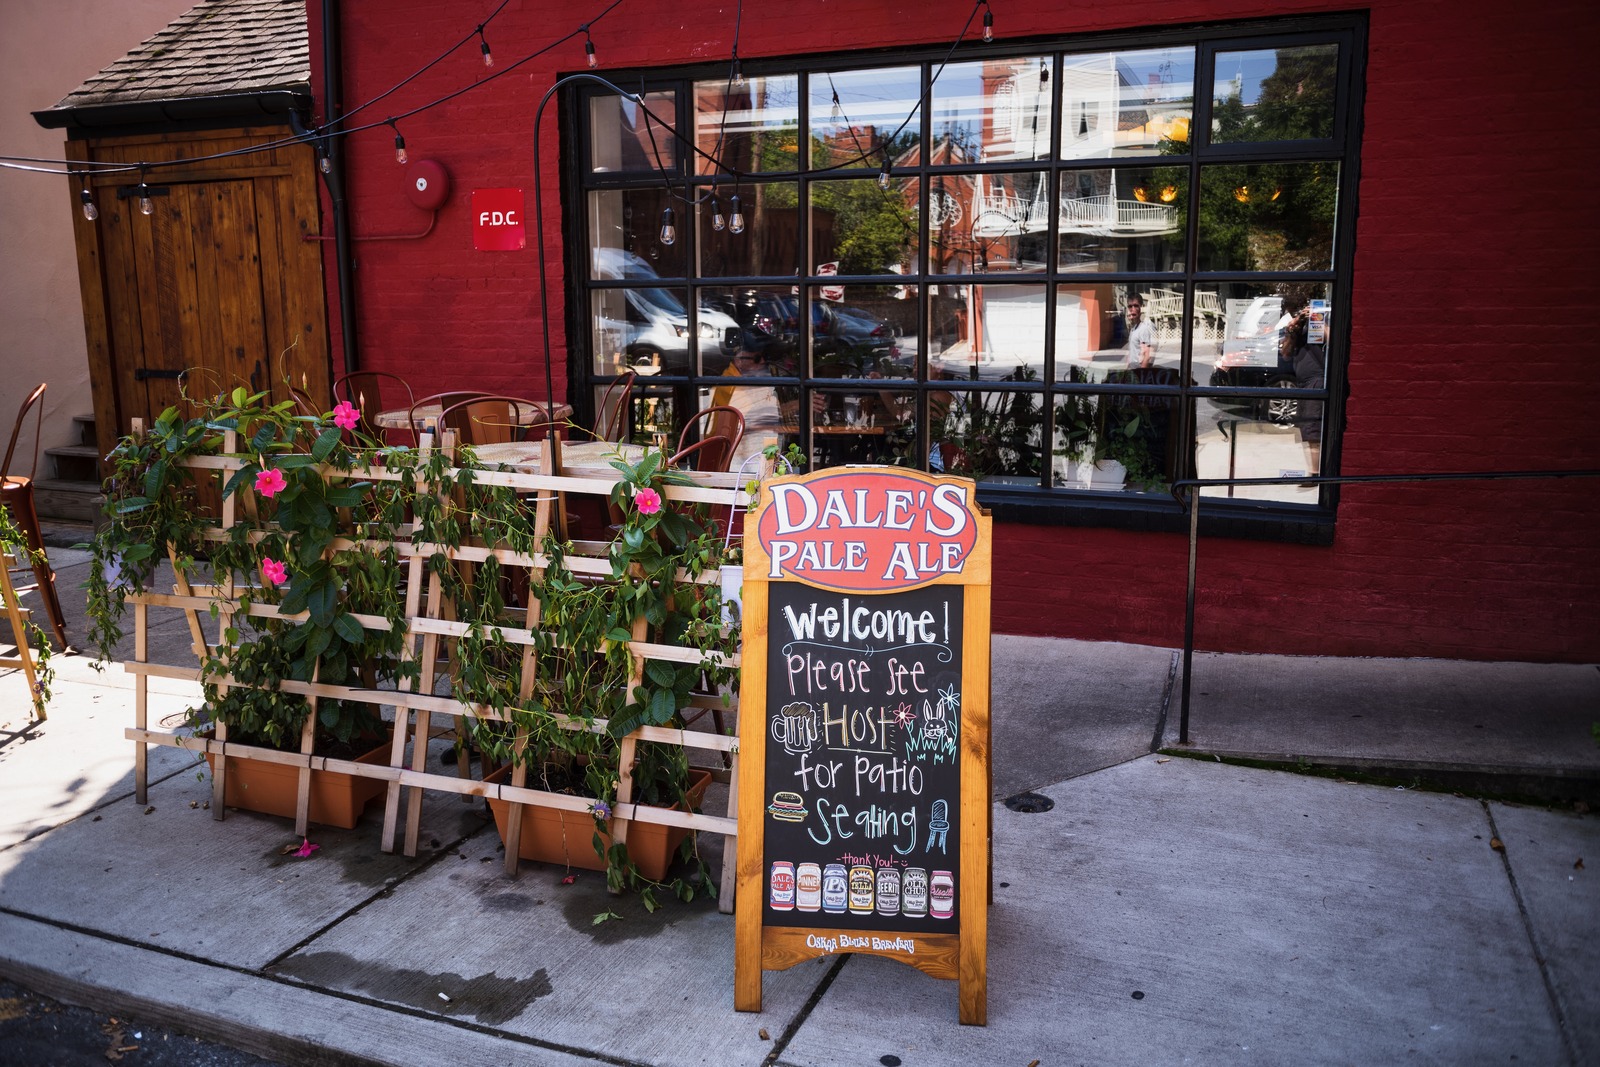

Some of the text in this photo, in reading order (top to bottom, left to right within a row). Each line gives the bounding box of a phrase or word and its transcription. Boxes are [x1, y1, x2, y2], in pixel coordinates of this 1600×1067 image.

[480, 211, 519, 226] F.D.C.
[769, 483, 967, 537] DALE'S
[768, 540, 965, 580] PALE ALE
[786, 652, 871, 696] Please
[794, 754, 843, 792] for
[807, 798, 917, 855] Seating
[824, 878, 847, 892] IPA
[906, 880, 925, 889] OLD
